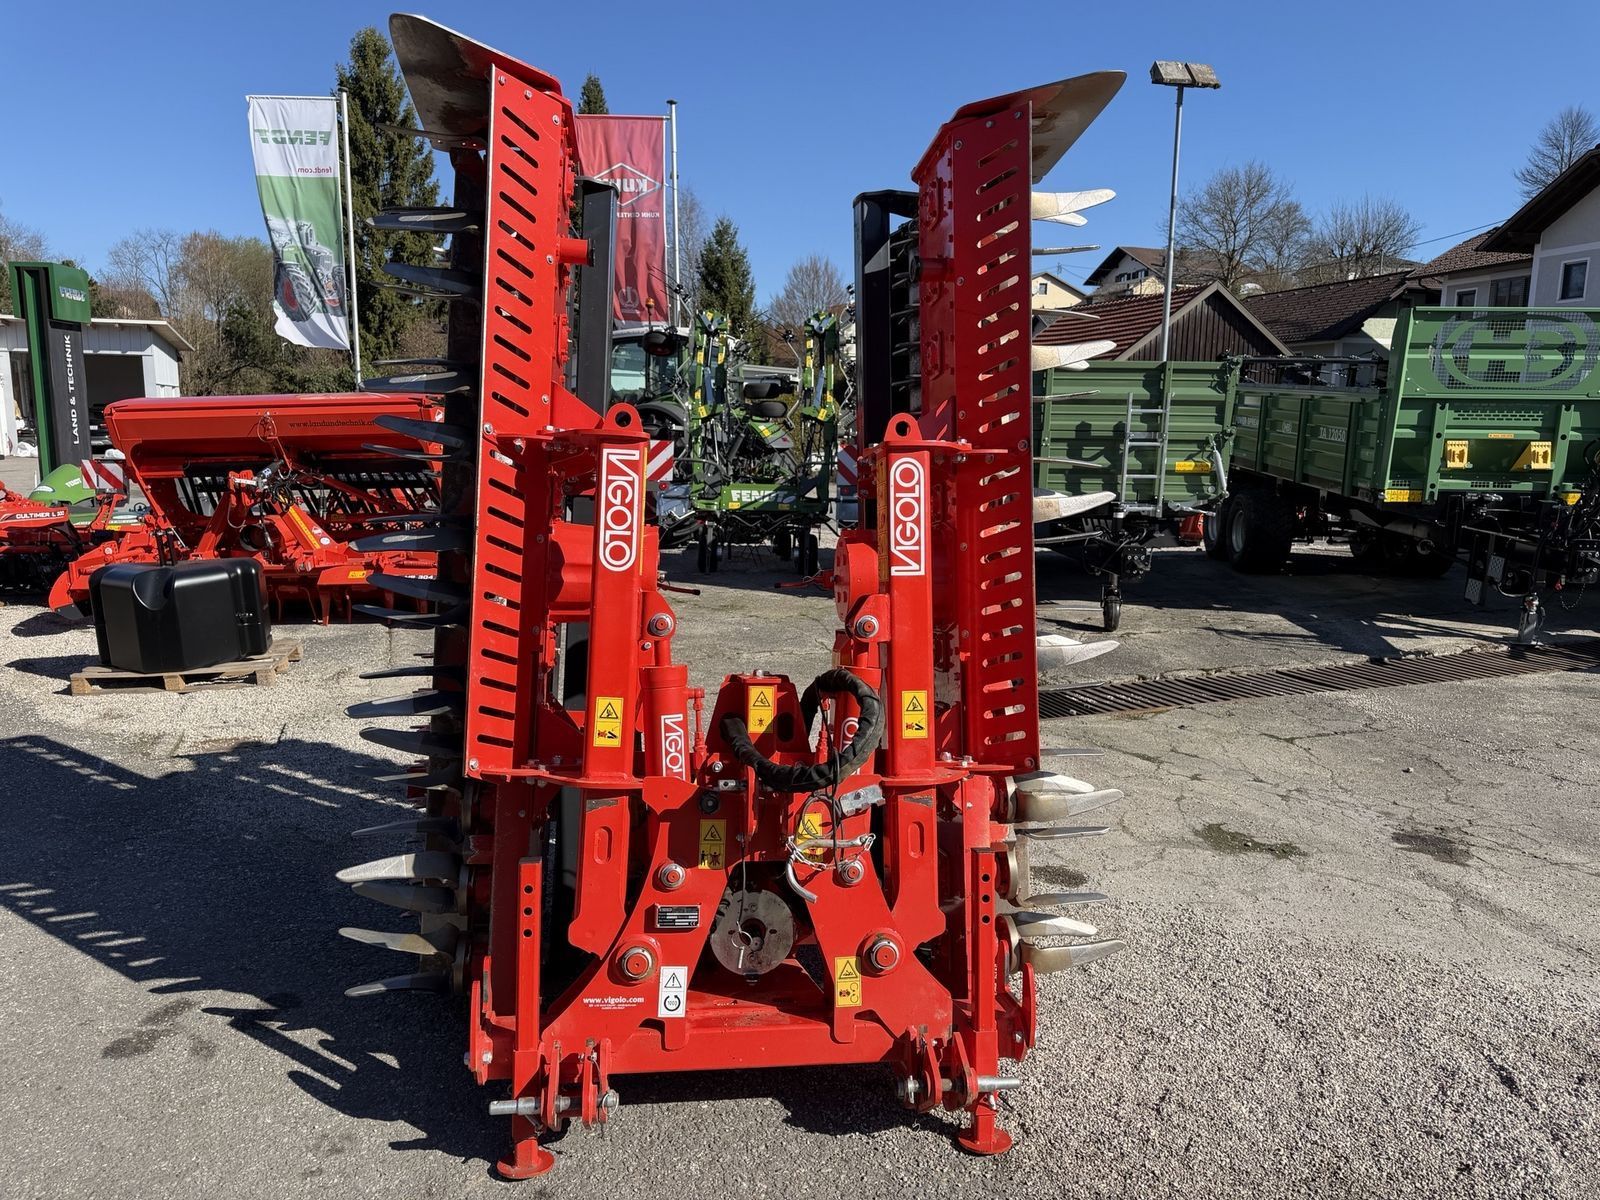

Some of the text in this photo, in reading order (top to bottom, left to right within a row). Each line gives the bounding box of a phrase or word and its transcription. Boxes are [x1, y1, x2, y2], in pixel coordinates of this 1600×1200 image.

[64, 334, 80, 445] LAND & TECHNIK
[600, 448, 640, 572] VIGOLO
[890, 457, 925, 576] VIGOLO
[583, 995, 645, 1004] www.vigolo.com
